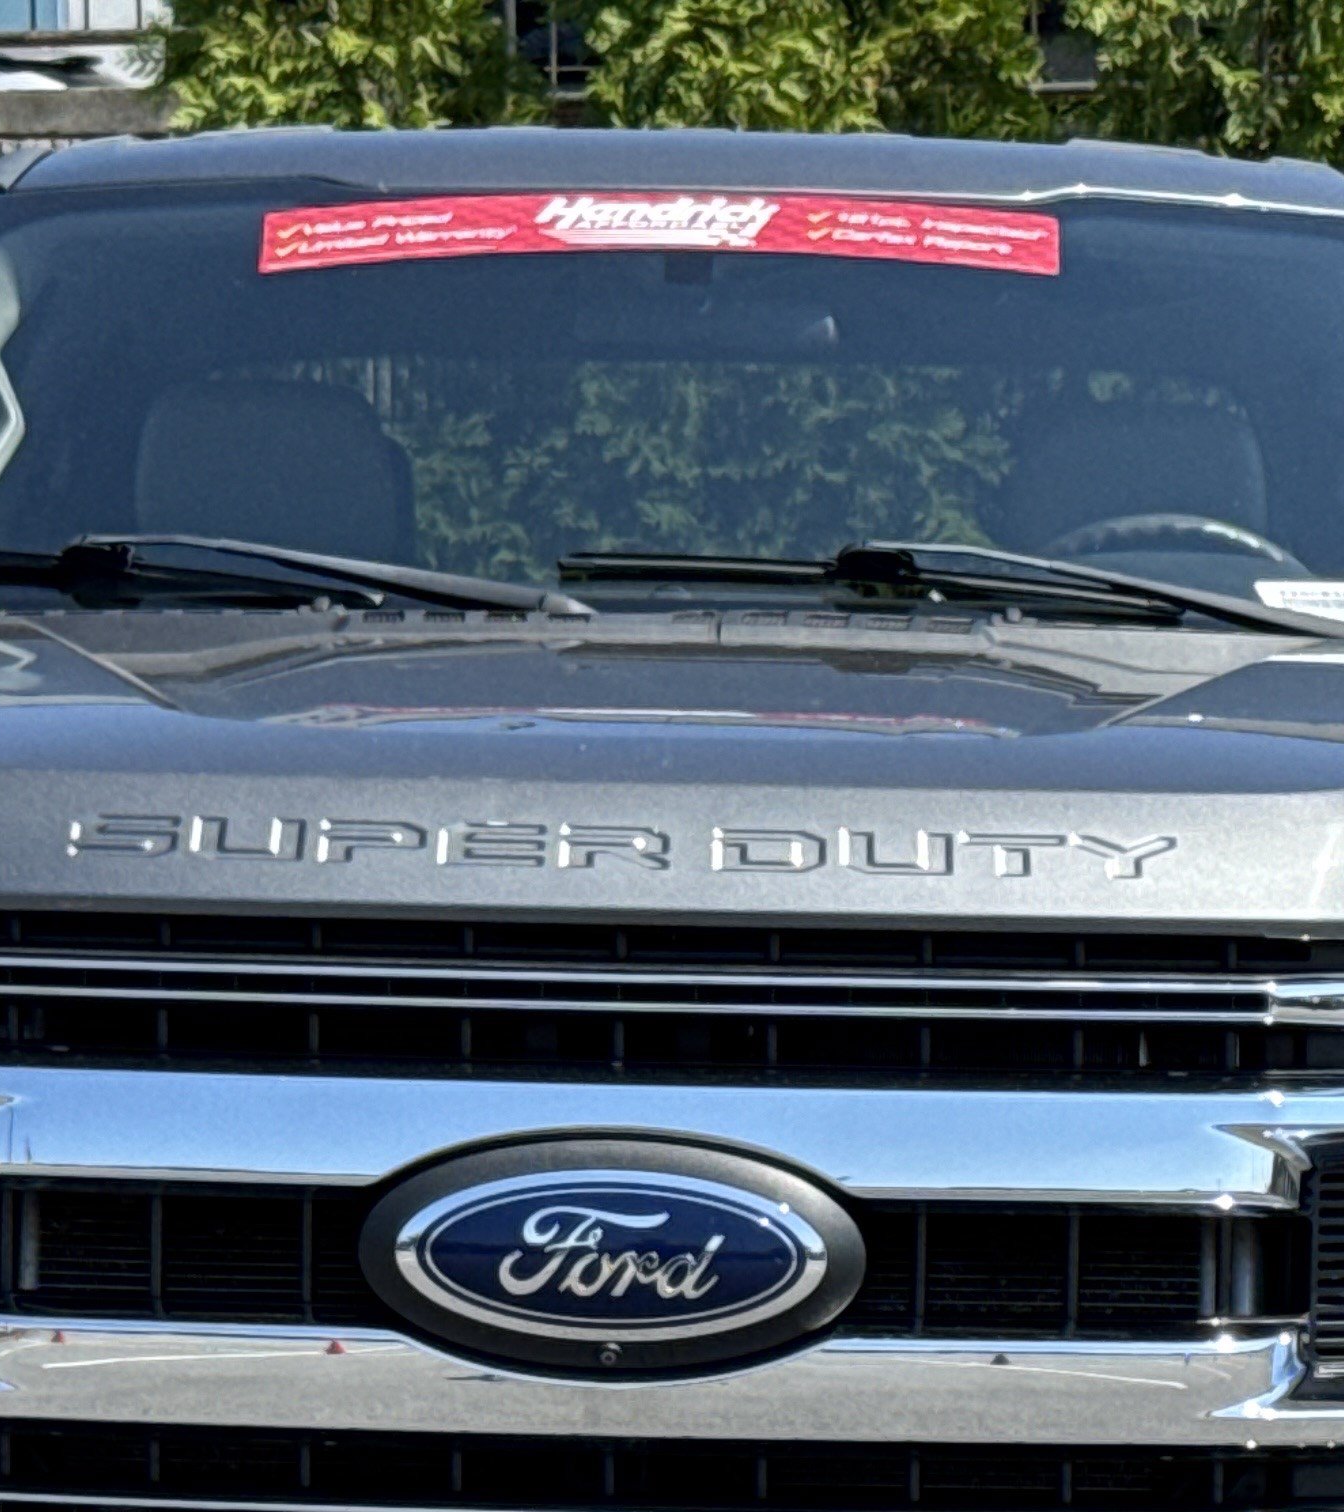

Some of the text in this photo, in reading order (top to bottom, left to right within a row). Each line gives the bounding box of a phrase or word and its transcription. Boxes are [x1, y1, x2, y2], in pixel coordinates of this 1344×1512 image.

[67, 812, 1179, 882] SUPER DUTY
[498, 1204, 726, 1300] Ford
